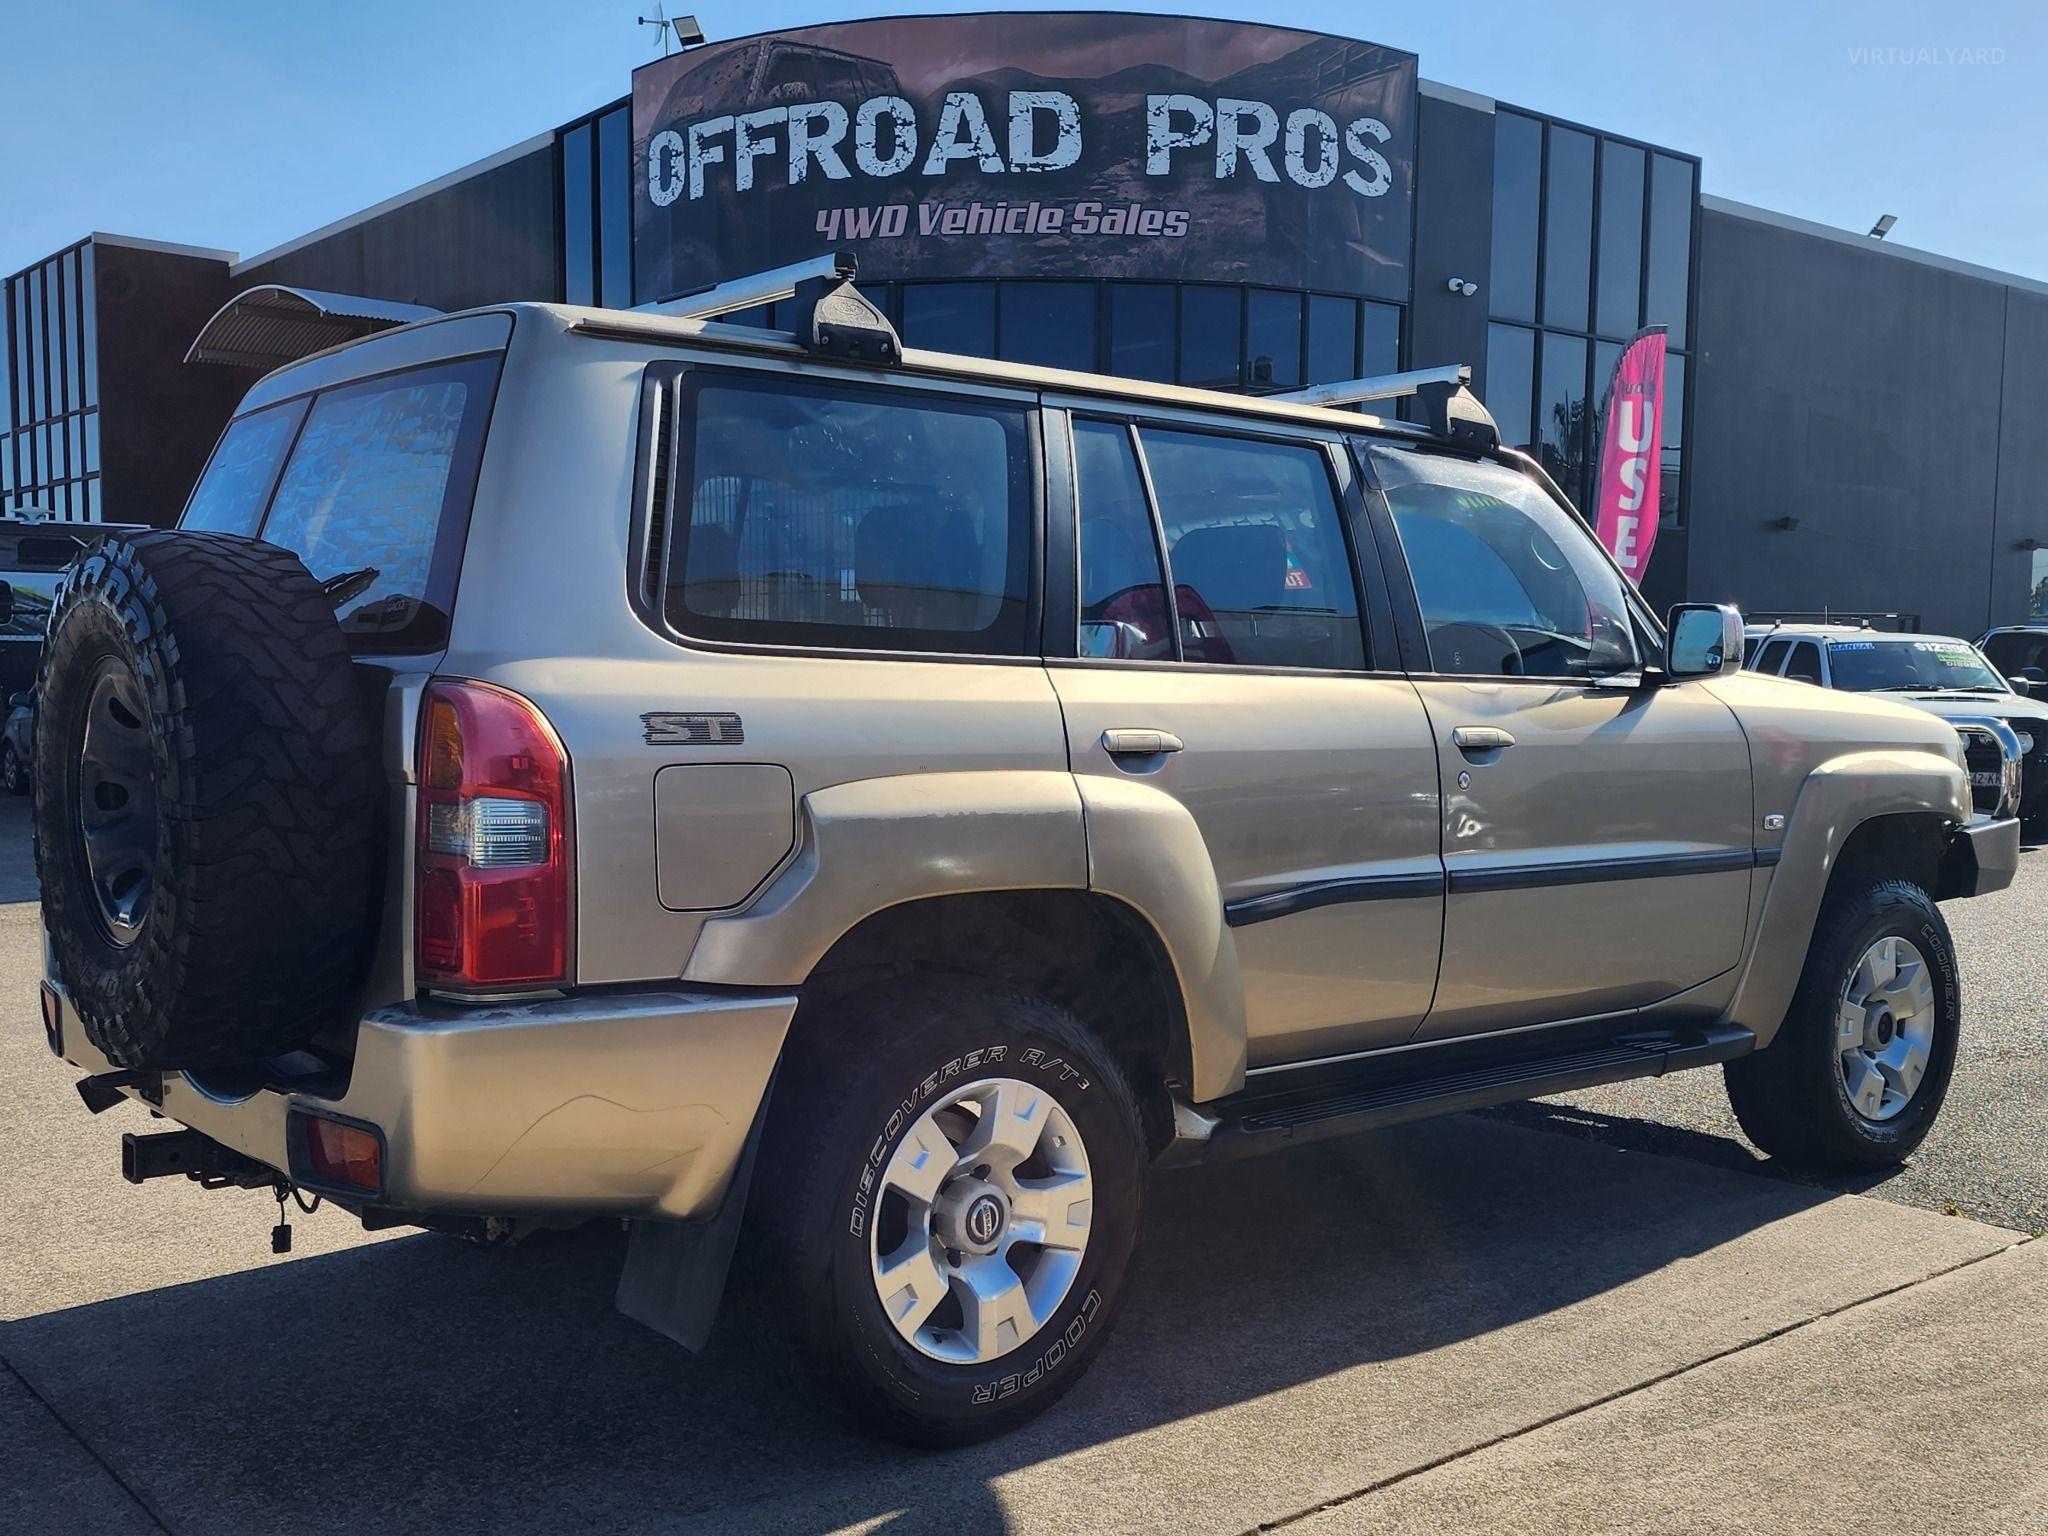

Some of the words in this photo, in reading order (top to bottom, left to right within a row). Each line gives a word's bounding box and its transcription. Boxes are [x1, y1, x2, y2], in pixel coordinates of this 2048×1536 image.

[648, 90, 1083, 207] OFFROAD
[1144, 93, 1394, 198] PROS
[815, 203, 907, 242] 4WD
[918, 200, 1064, 237] Vehicle
[1071, 201, 1190, 238] Sales
[650, 715, 736, 741] ST
[1920, 923, 1956, 1022] COOPER
[848, 1045, 1009, 1240] DISCOVERER
[982, 1202, 993, 1239] NISSAN
[970, 1288, 1103, 1406] COOPER
